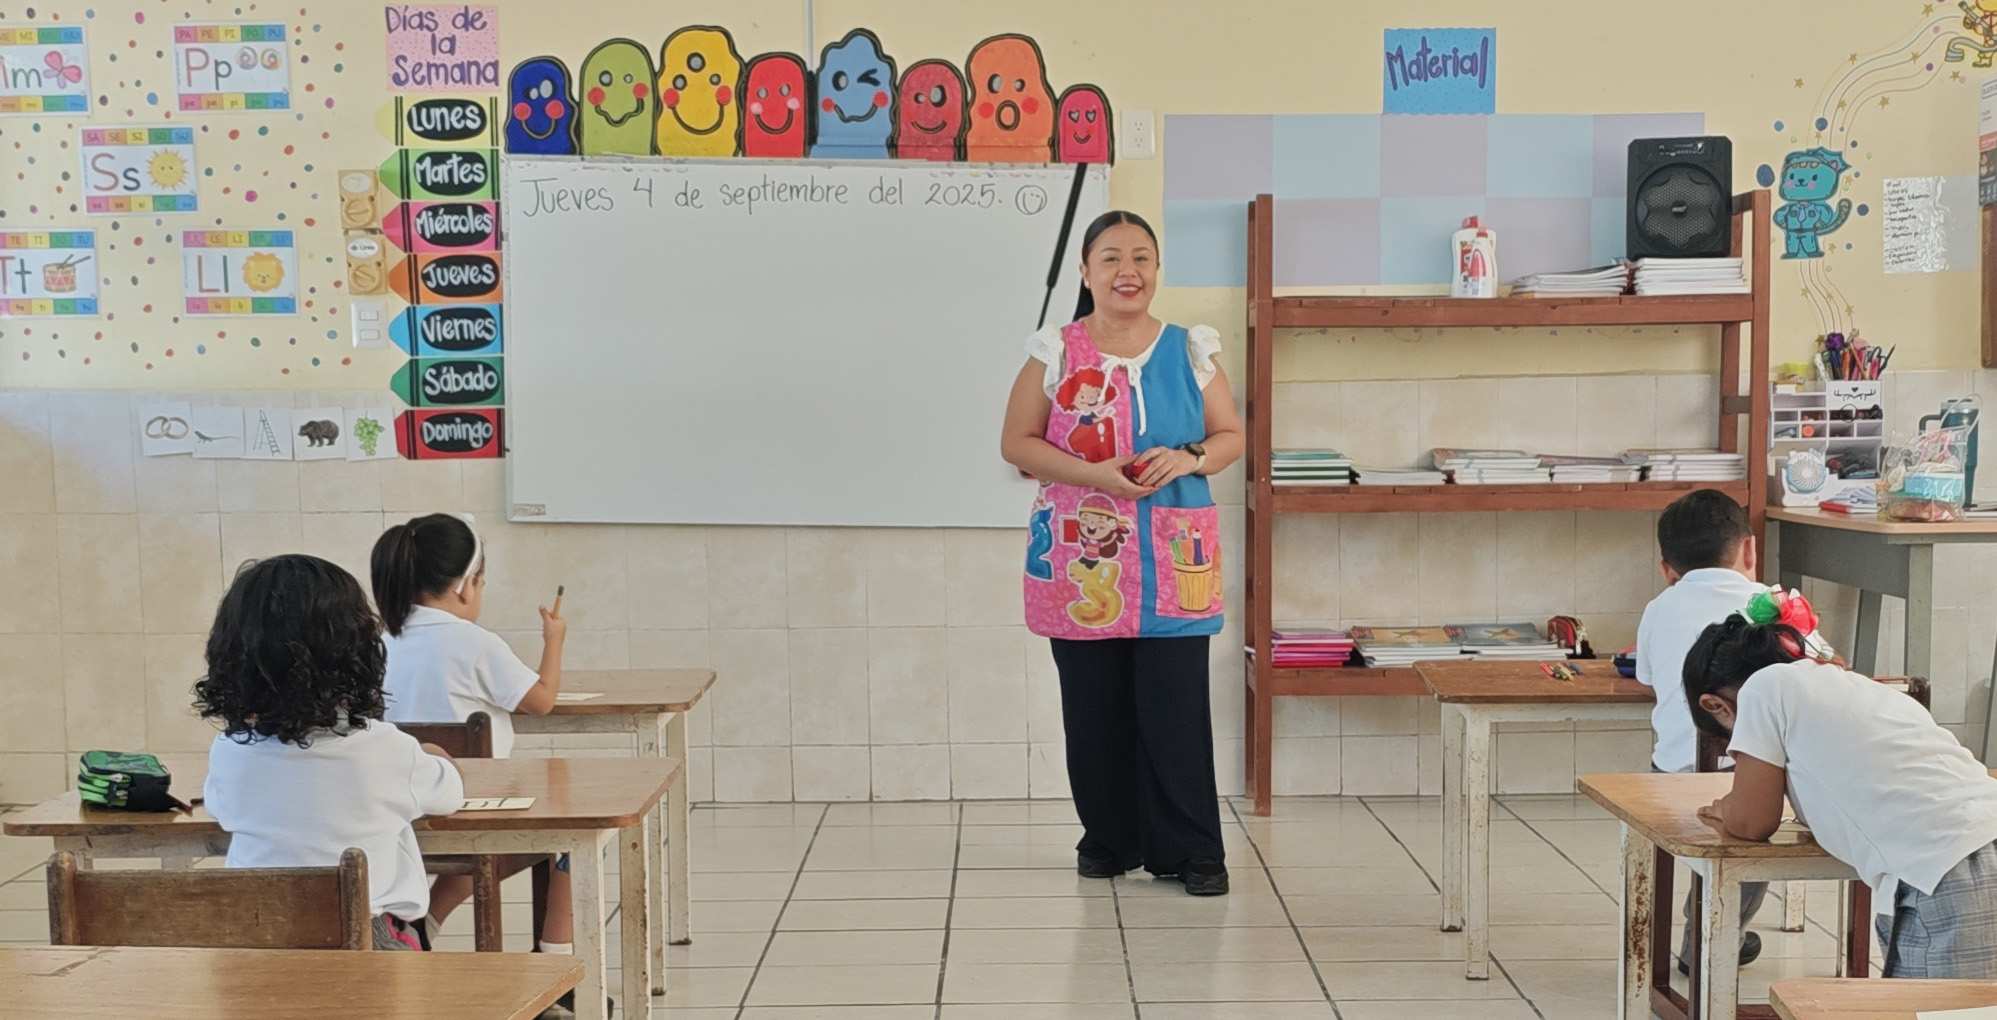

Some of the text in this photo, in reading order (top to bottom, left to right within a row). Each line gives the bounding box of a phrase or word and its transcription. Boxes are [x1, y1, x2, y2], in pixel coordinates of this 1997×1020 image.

[180, 30, 192, 39] PA
[202, 30, 213, 39] PE
[225, 29, 236, 39] PI
[385, 5, 488, 34] Días de
[431, 33, 457, 56] la
[392, 54, 500, 87] Semana
[1386, 36, 1489, 91] Material
[87, 132, 100, 141] SA
[109, 132, 121, 141] SE
[132, 132, 143, 141] SI
[415, 154, 486, 187] Martes
[520, 174, 1003, 217] Jueves 4 de septiembre del 2025.
[416, 205, 493, 239] Miércoles
[33, 235, 44, 245] TI
[422, 263, 496, 289] Jueves
[422, 314, 497, 343] Viernes
[424, 364, 498, 396] Sábado
[422, 417, 494, 449] Domingo
[1067, 559, 1123, 629] 3
